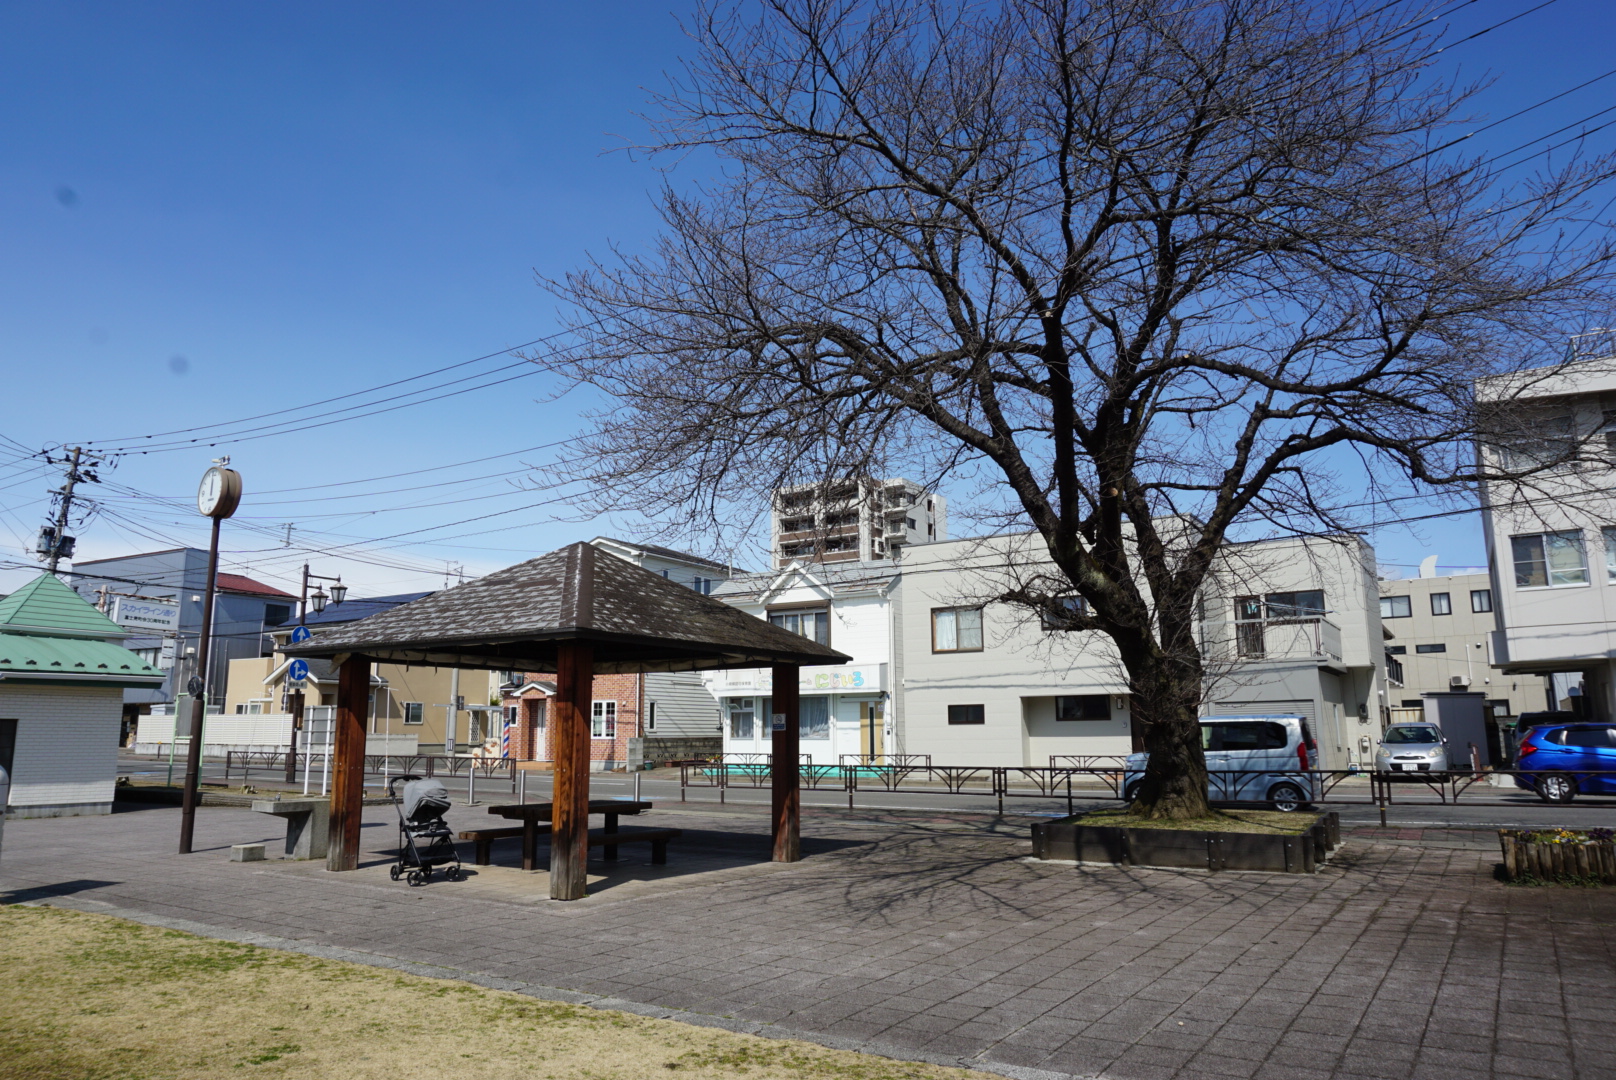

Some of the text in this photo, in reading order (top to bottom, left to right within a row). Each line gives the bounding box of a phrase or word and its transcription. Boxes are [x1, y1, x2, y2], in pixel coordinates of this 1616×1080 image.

[121, 603, 176, 617] スカイライン通り
[815, 671, 864, 689] にじいろ
